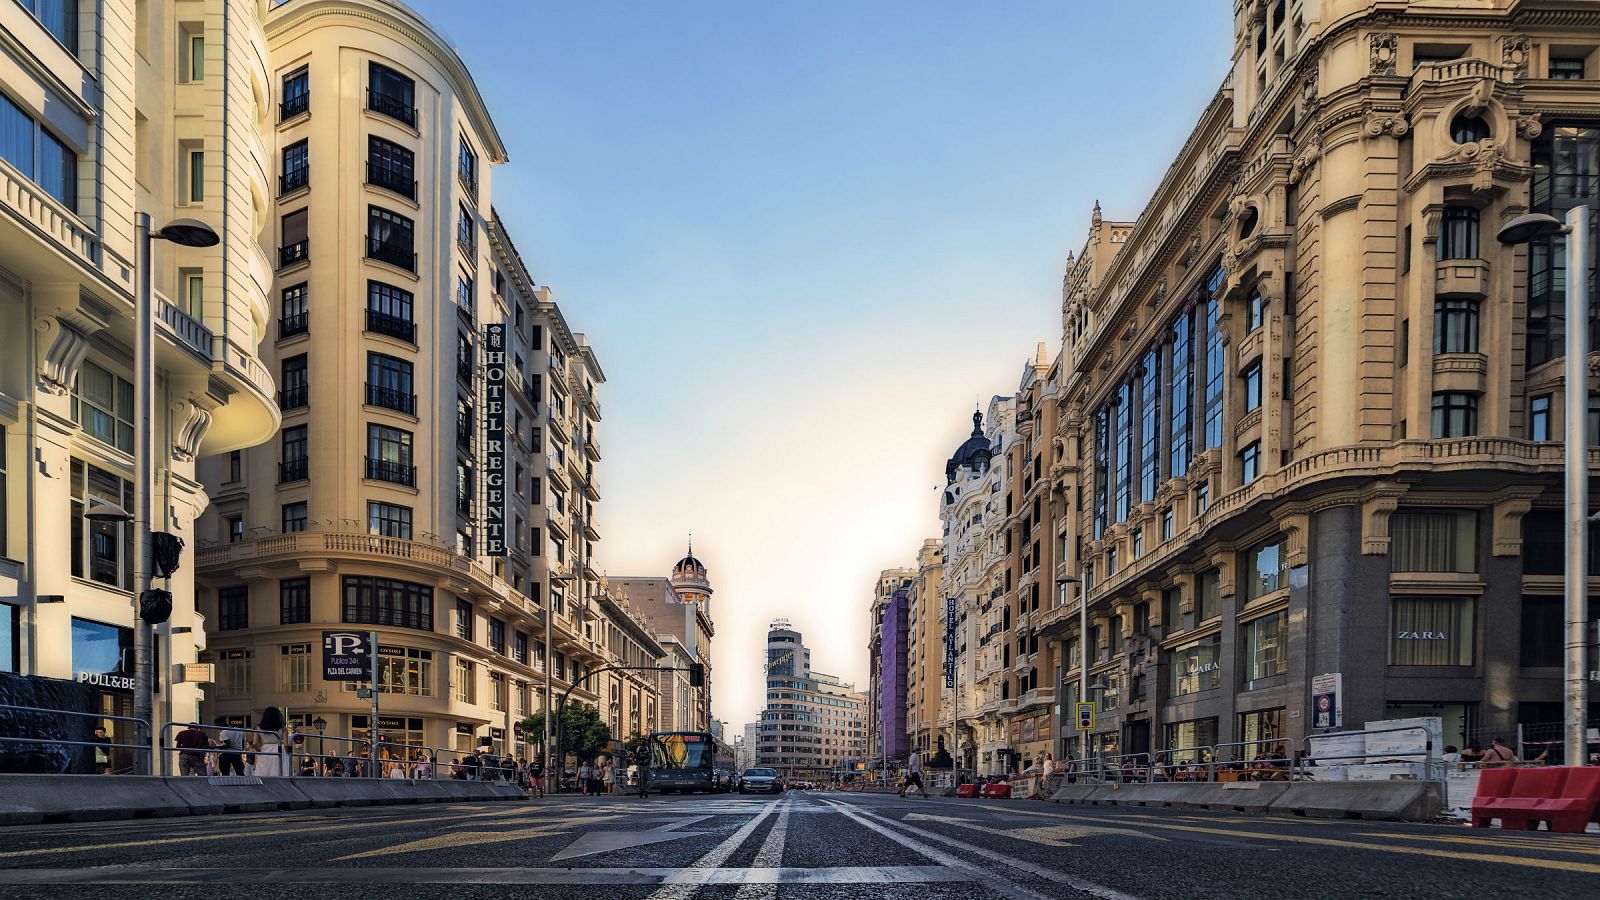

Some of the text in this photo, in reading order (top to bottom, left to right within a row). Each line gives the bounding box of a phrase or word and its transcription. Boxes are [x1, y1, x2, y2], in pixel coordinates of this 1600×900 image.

[486, 351, 505, 552] HOTEL REGENTE
[1398, 631, 1447, 640] ZARA
[330, 634, 361, 656] P
[327, 667, 363, 675] PLZA DEL CARMEN
